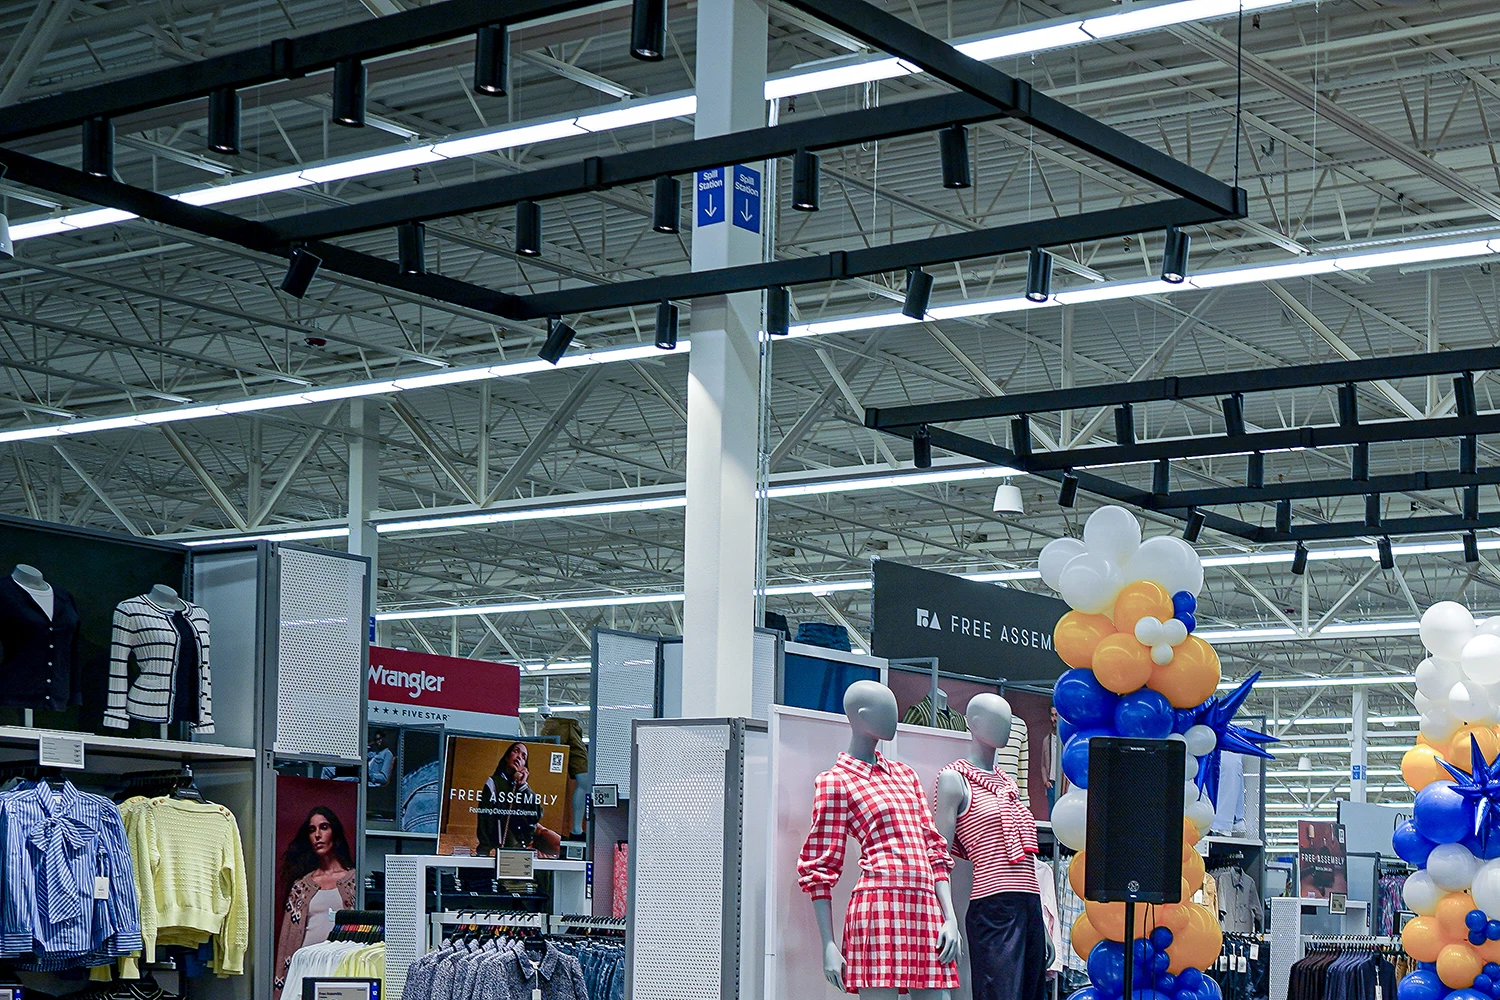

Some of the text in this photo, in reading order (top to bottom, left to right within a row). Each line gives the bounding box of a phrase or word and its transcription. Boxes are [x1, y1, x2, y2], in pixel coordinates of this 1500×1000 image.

[703, 169, 719, 181] Spill
[740, 173, 755, 186] Spill
[698, 179, 723, 191] Station
[735, 181, 759, 197] Station
[951, 614, 1058, 651] FREE ASSEM
[368, 664, 445, 699] Wrangler
[402, 709, 449, 722] FIVE STAR
[450, 788, 558, 806] FREE ASSEMBLY
[469, 806, 492, 815] Featuring
[1301, 853, 1345, 865] FREE ASSEMBLY
